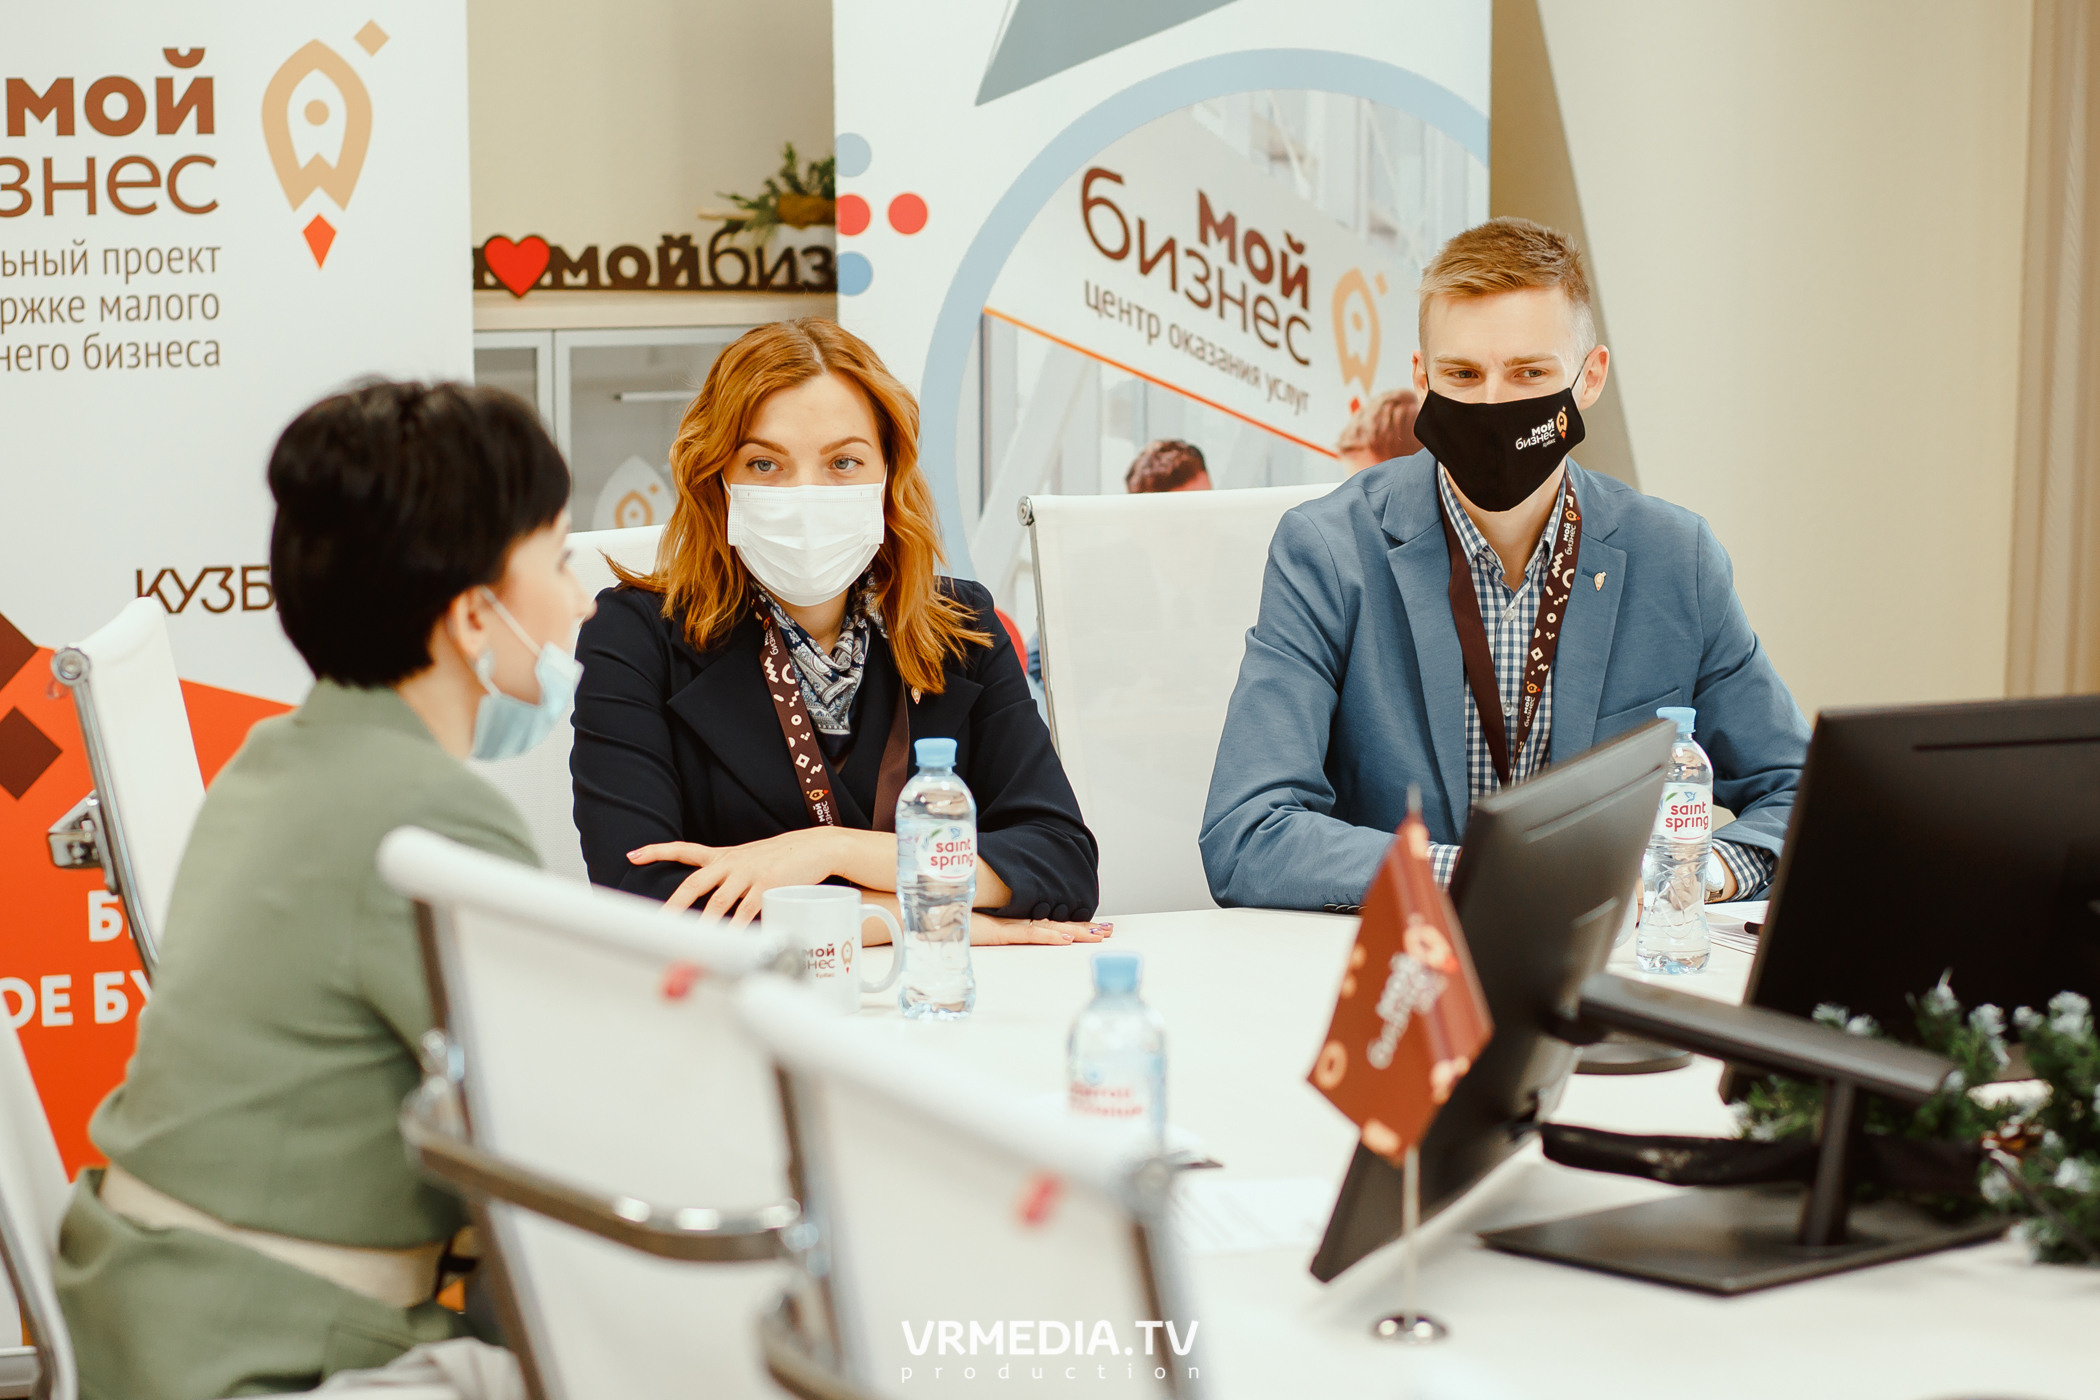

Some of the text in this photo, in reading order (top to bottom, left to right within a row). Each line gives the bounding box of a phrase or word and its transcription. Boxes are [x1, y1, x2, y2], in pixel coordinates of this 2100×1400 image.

[5, 47, 216, 137] мой
[1, 238, 222, 285] ьный проект
[1197, 188, 1311, 312] мой
[1081, 166, 1312, 367] бизнес
[0, 293, 221, 334] ржке малого
[1084, 279, 1161, 346] центр
[1168, 322, 1262, 389] оказания
[83, 331, 221, 371] бизнеса
[1515, 428, 1556, 450] бизнес
[1531, 418, 1555, 437] мой
[812, 802, 825, 823] мой
[1665, 815, 1709, 832] spring
[1670, 801, 1706, 816] saint
[935, 837, 971, 853] saint
[930, 852, 974, 871] spring
